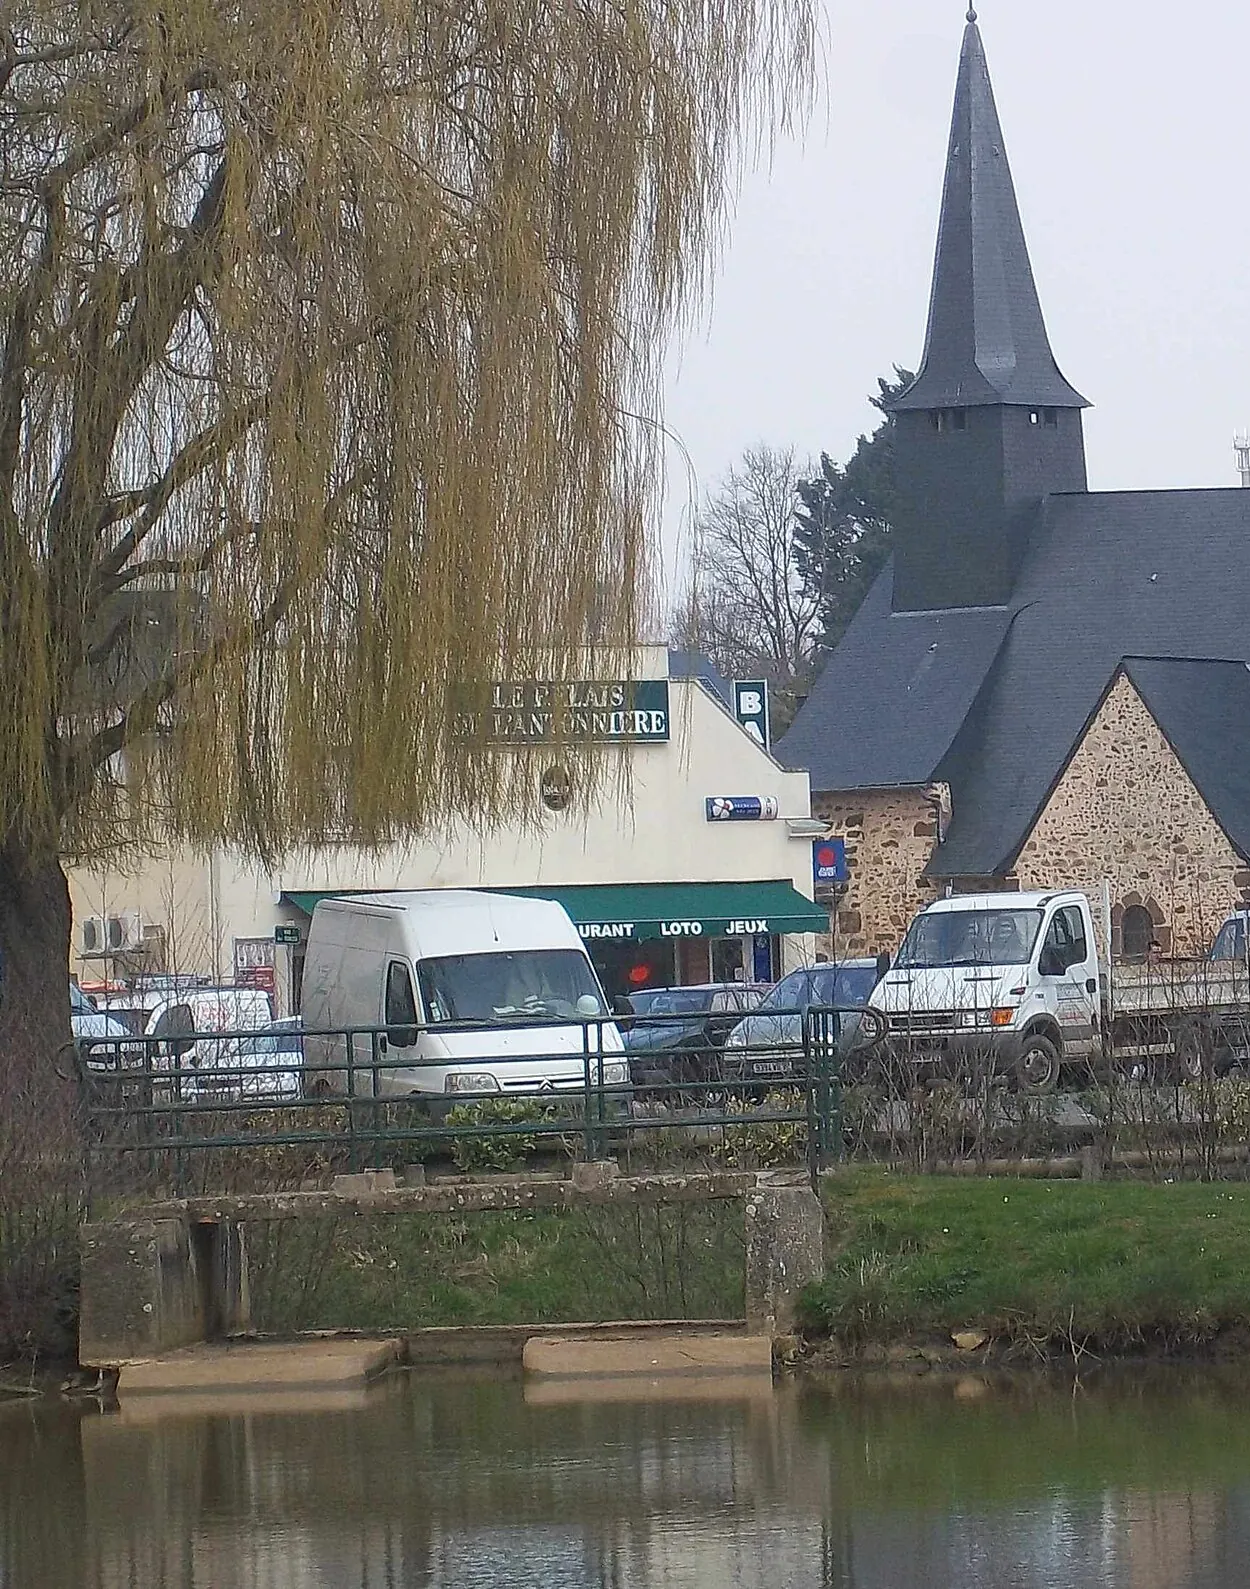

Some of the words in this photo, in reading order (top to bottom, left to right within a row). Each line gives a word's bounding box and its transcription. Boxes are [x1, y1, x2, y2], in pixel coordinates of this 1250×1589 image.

[578, 923, 634, 938] URANT
[661, 921, 703, 936] LOTO
[725, 920, 769, 934] JEUX
